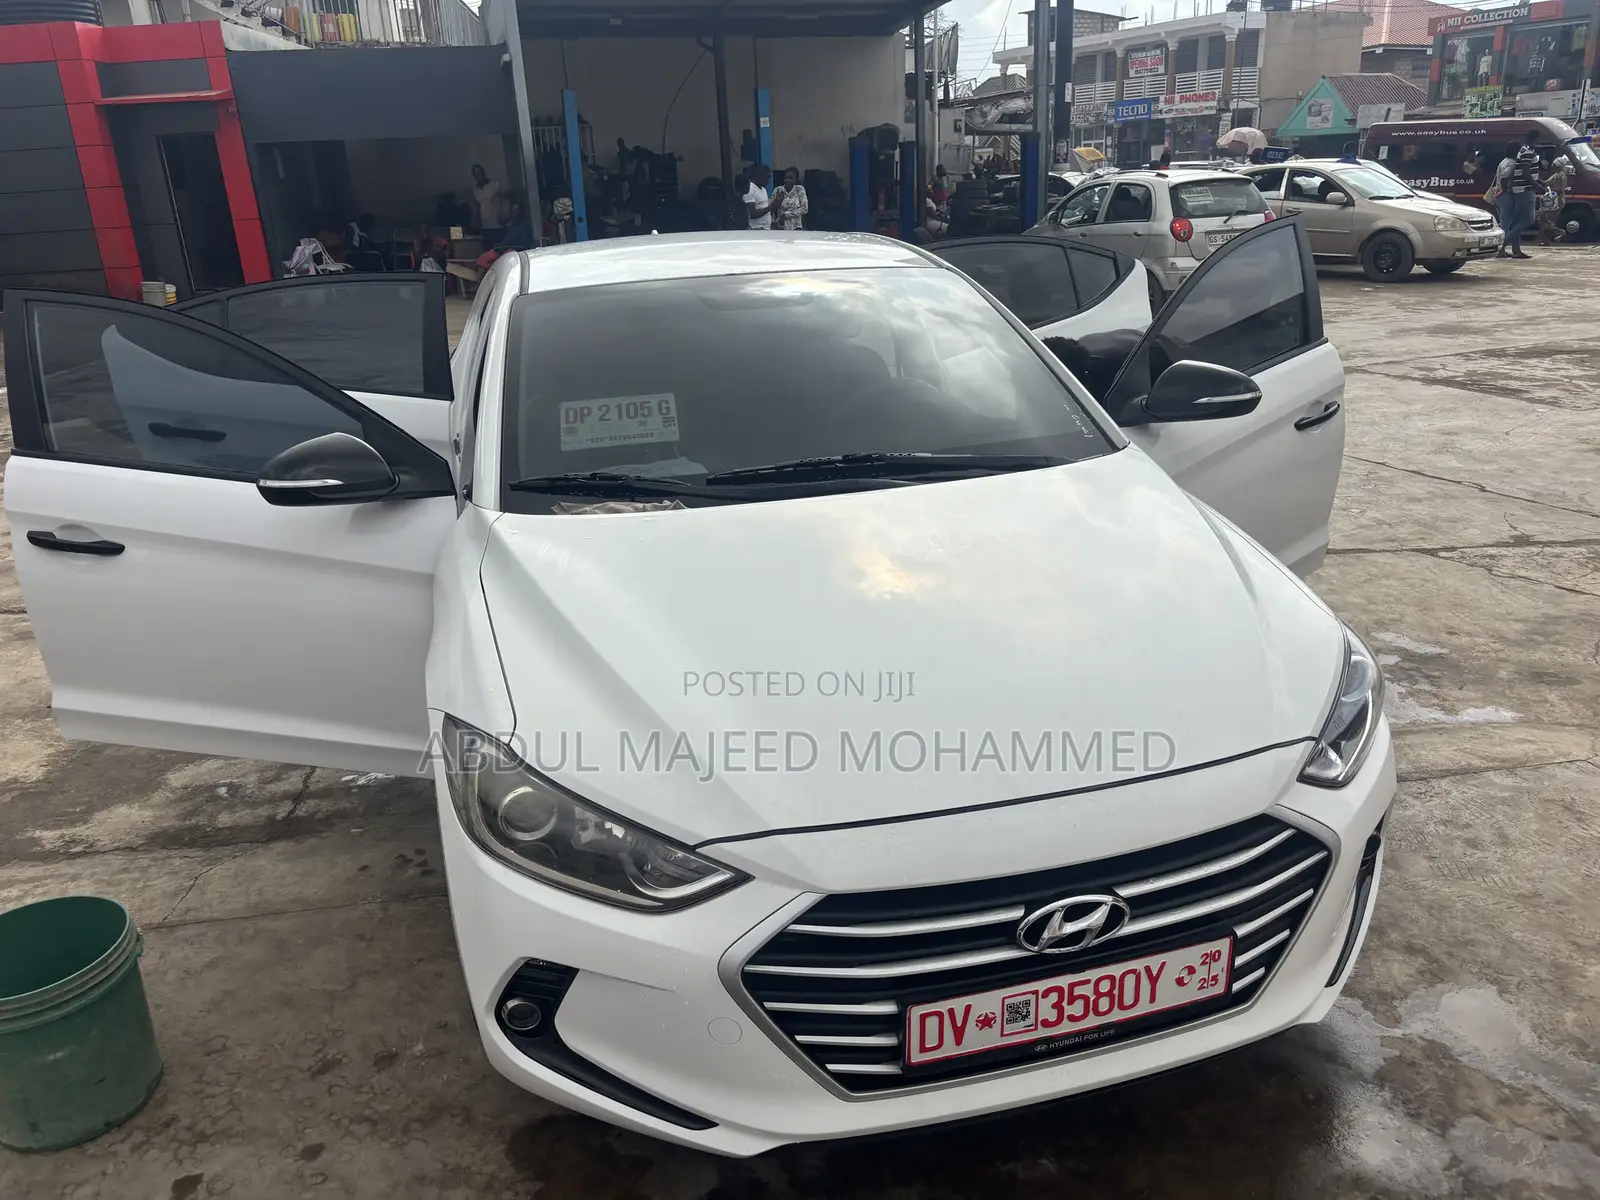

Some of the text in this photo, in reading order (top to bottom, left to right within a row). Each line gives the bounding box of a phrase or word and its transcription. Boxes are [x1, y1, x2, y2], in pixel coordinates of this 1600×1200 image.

[1464, 7, 1528, 25] COLLECTION
[1179, 91, 1217, 104] PHONES
[1117, 103, 1148, 117] TECNO
[565, 399, 672, 425] DP 2105 G
[919, 960, 1167, 1054] DV 3580Y
[1049, 1028, 1115, 1049] HYUNDAI FOR LIFE
